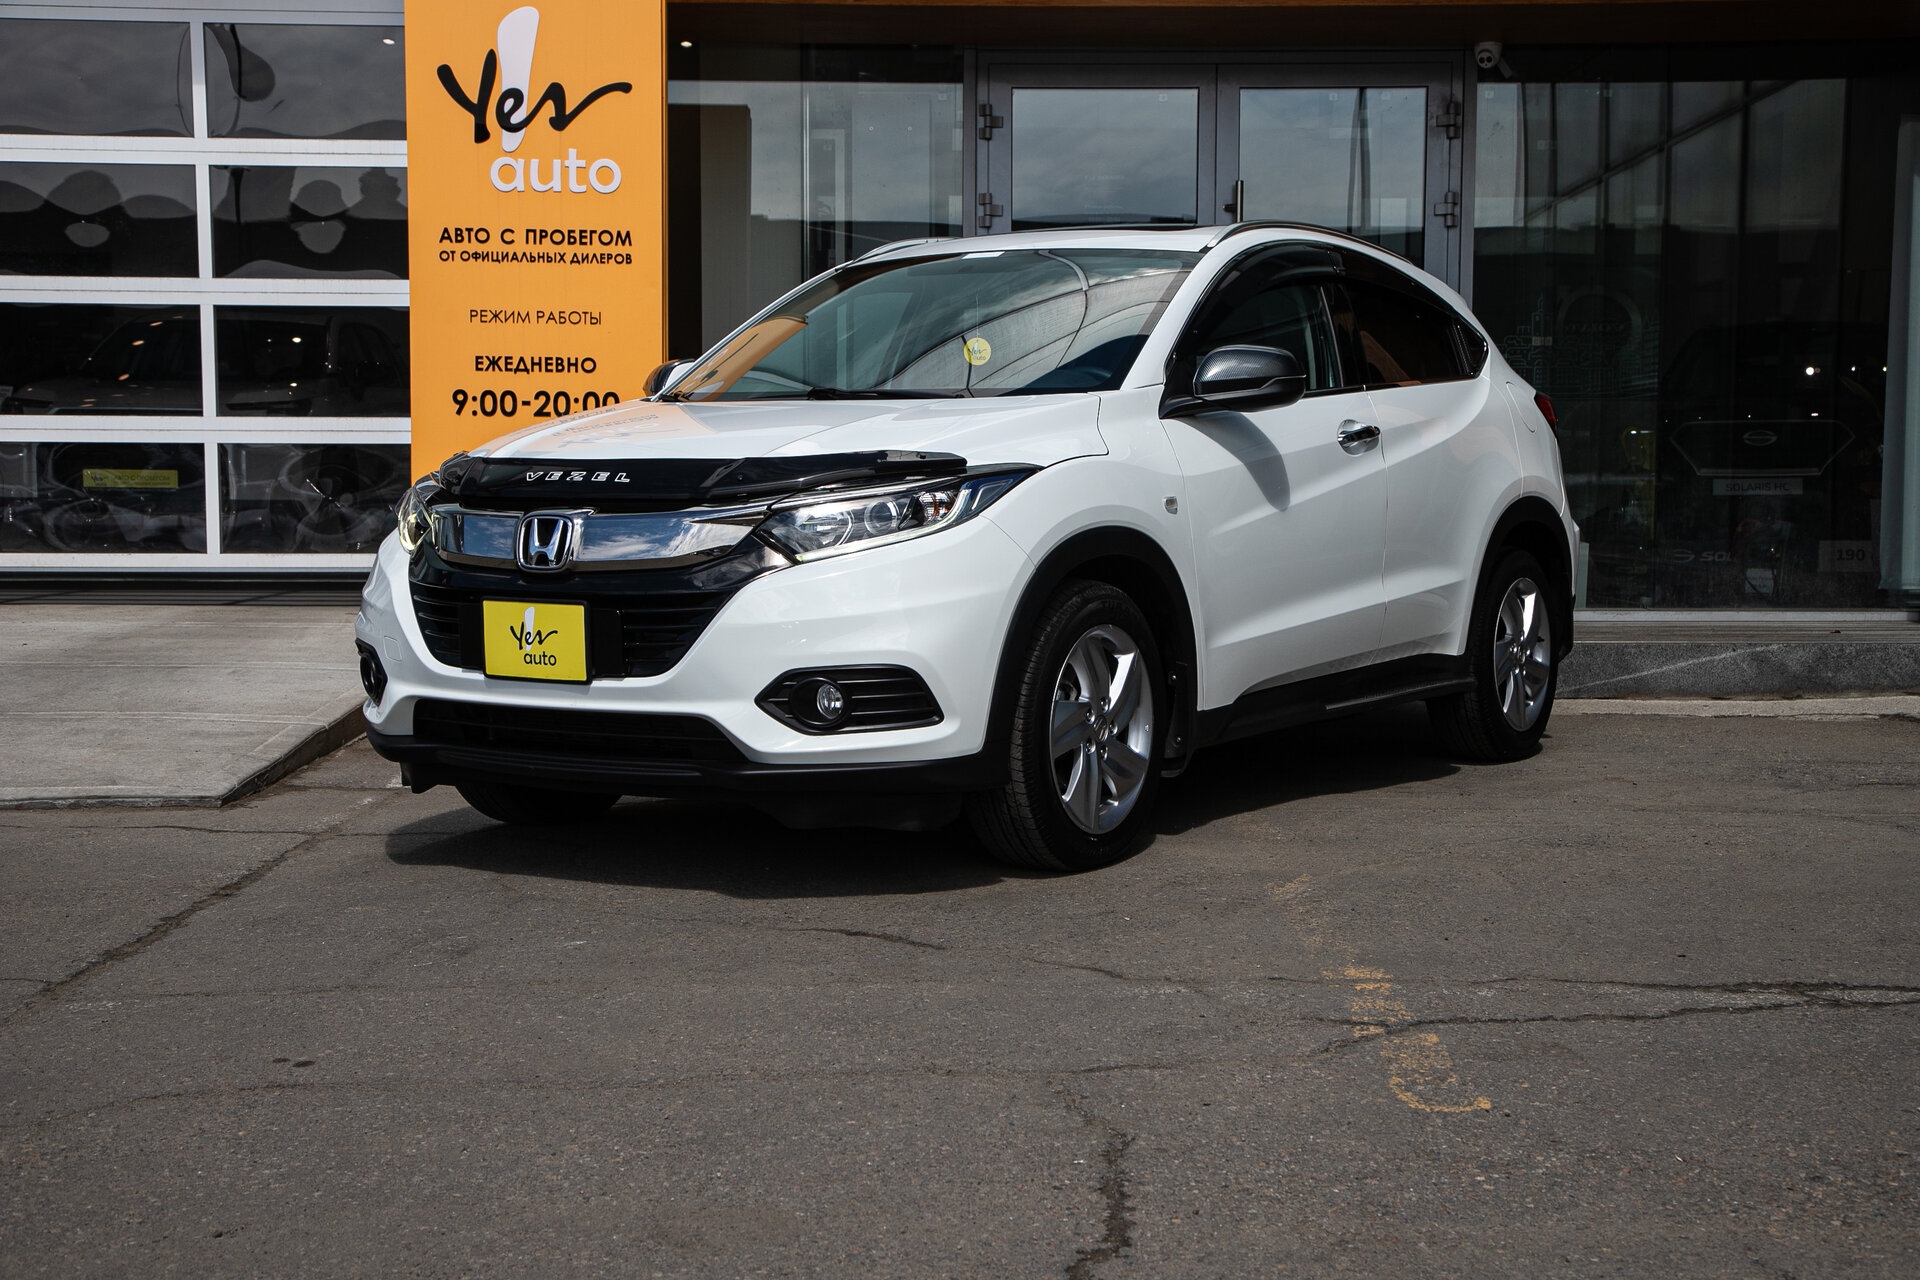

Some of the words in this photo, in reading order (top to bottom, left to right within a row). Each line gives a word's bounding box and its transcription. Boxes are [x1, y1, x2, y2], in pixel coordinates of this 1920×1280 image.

[437, 48, 632, 144] Yes
[490, 148, 622, 194] auto
[439, 227, 490, 244] АВТО
[500, 228, 515, 245] С
[525, 229, 632, 246] ПРОБЕГОМ
[439, 250, 455, 262] ОТ
[460, 250, 566, 264] ОФИЦИАЛЬНЫХ
[570, 252, 632, 265] ДИЛЕРОВ
[469, 309, 531, 324] РЕЖИМ
[536, 311, 602, 325] РАБОТЫ
[475, 355, 597, 374] ЕЖЕДНЕВНО
[526, 471, 631, 483] VEZEL
[1836, 549, 1867, 561] 190
[510, 621, 558, 650] Yes
[524, 651, 557, 666] auto
